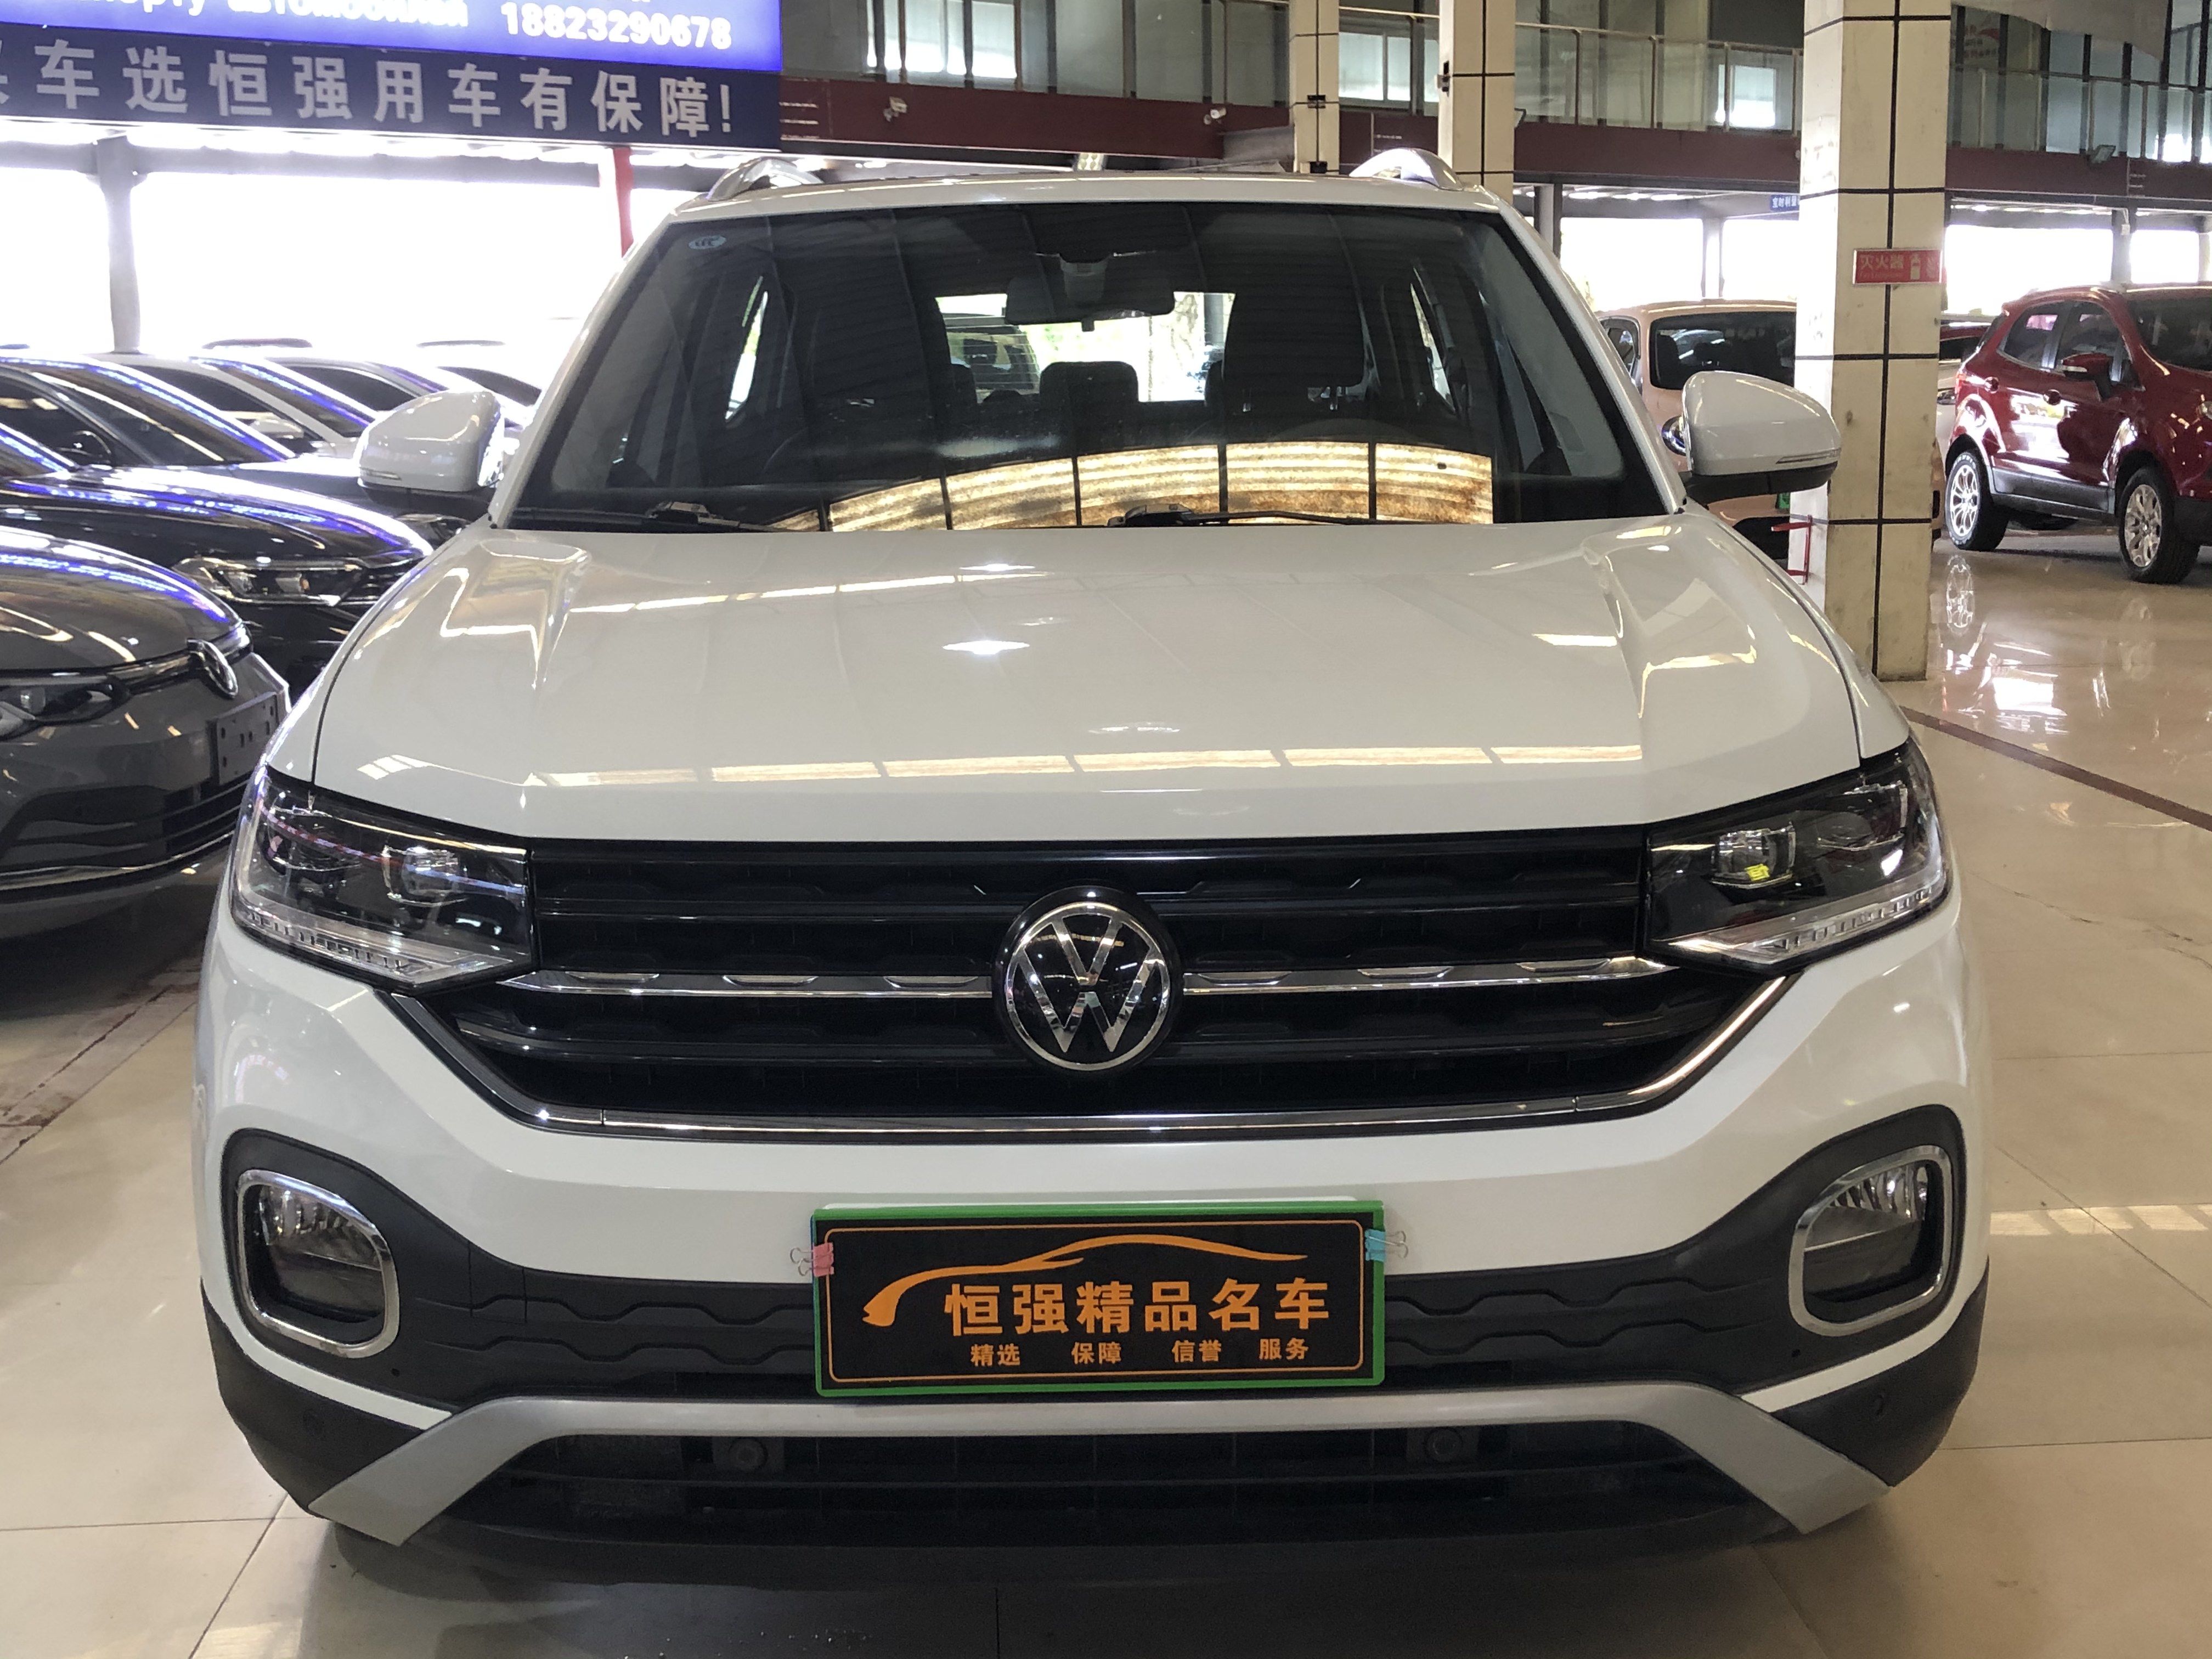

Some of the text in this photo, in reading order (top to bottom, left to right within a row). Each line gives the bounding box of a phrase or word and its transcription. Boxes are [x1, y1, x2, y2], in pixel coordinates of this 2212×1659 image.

[500, 2, 732, 49] 18823290678
[0, 38, 731, 138] 车选恒强用车有保障!
[944, 1277, 1329, 1336] 恒强精品名车
[970, 1338, 1308, 1366] 精选 保障 信誉 服务
